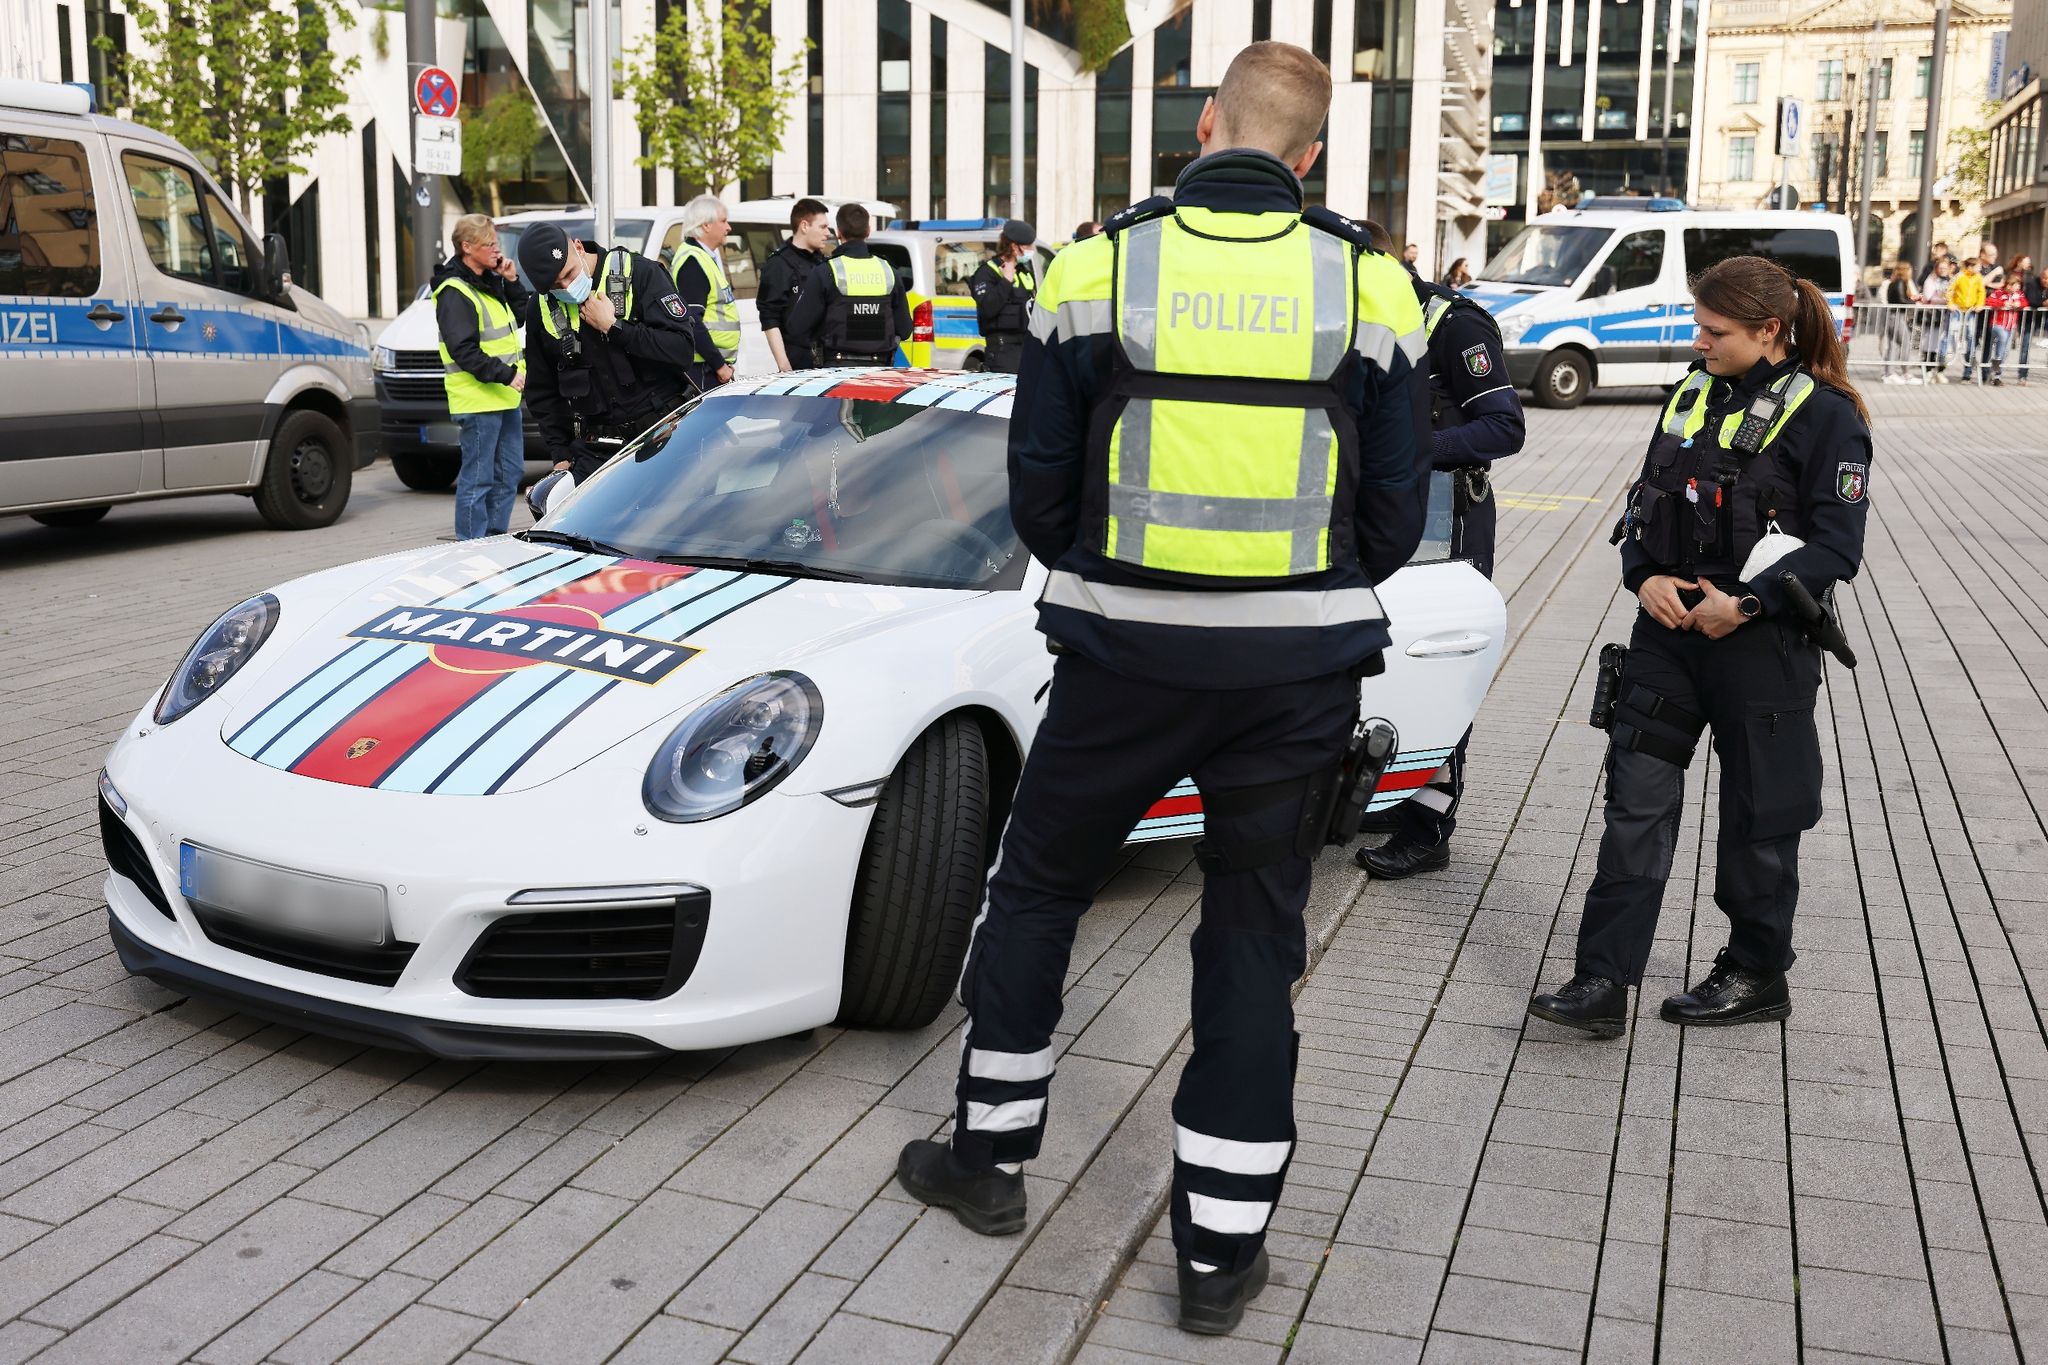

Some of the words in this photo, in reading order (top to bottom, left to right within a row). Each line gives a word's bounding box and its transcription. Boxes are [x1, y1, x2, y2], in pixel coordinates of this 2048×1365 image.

[849, 273, 883, 285] POLIZEI
[853, 303, 880, 315] NRW
[1170, 291, 1299, 334] POLIZEI
[1, 311, 58, 343] IZEI
[369, 611, 676, 675] MARTINI
